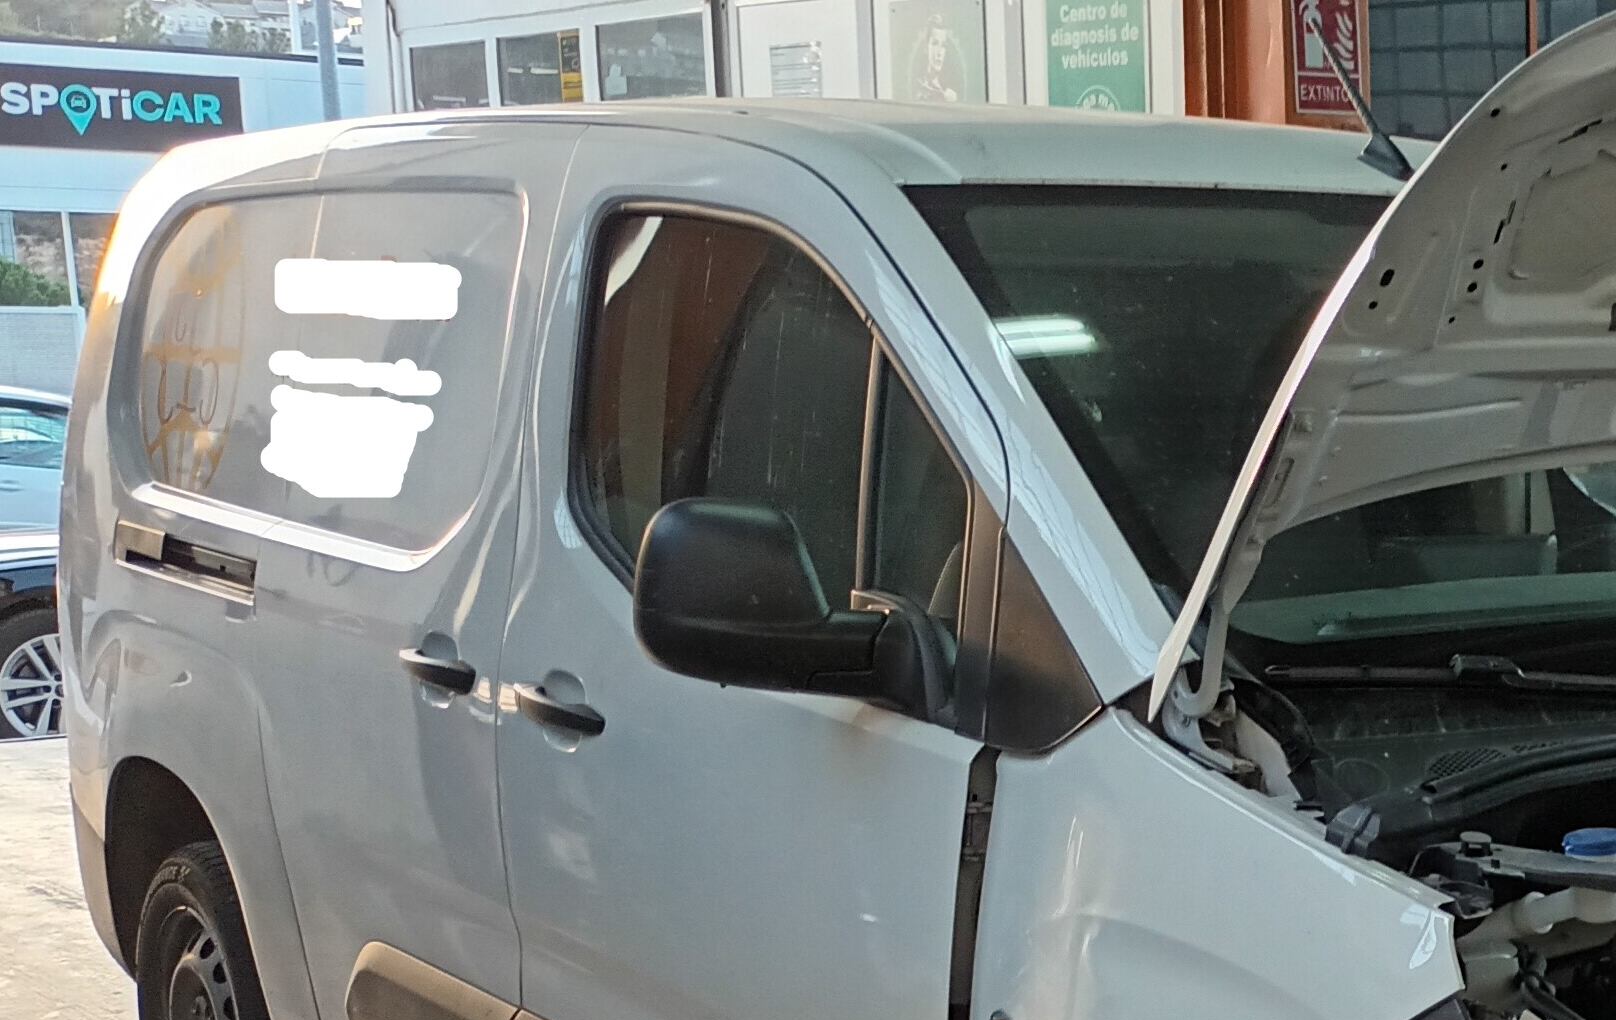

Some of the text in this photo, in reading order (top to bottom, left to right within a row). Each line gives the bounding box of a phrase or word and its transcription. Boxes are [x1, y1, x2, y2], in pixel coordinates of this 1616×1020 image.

[1060, 0, 1128, 22] Centro de
[1051, 21, 1139, 49] diagnosis de
[1300, 84, 1350, 103] EXTINTO
